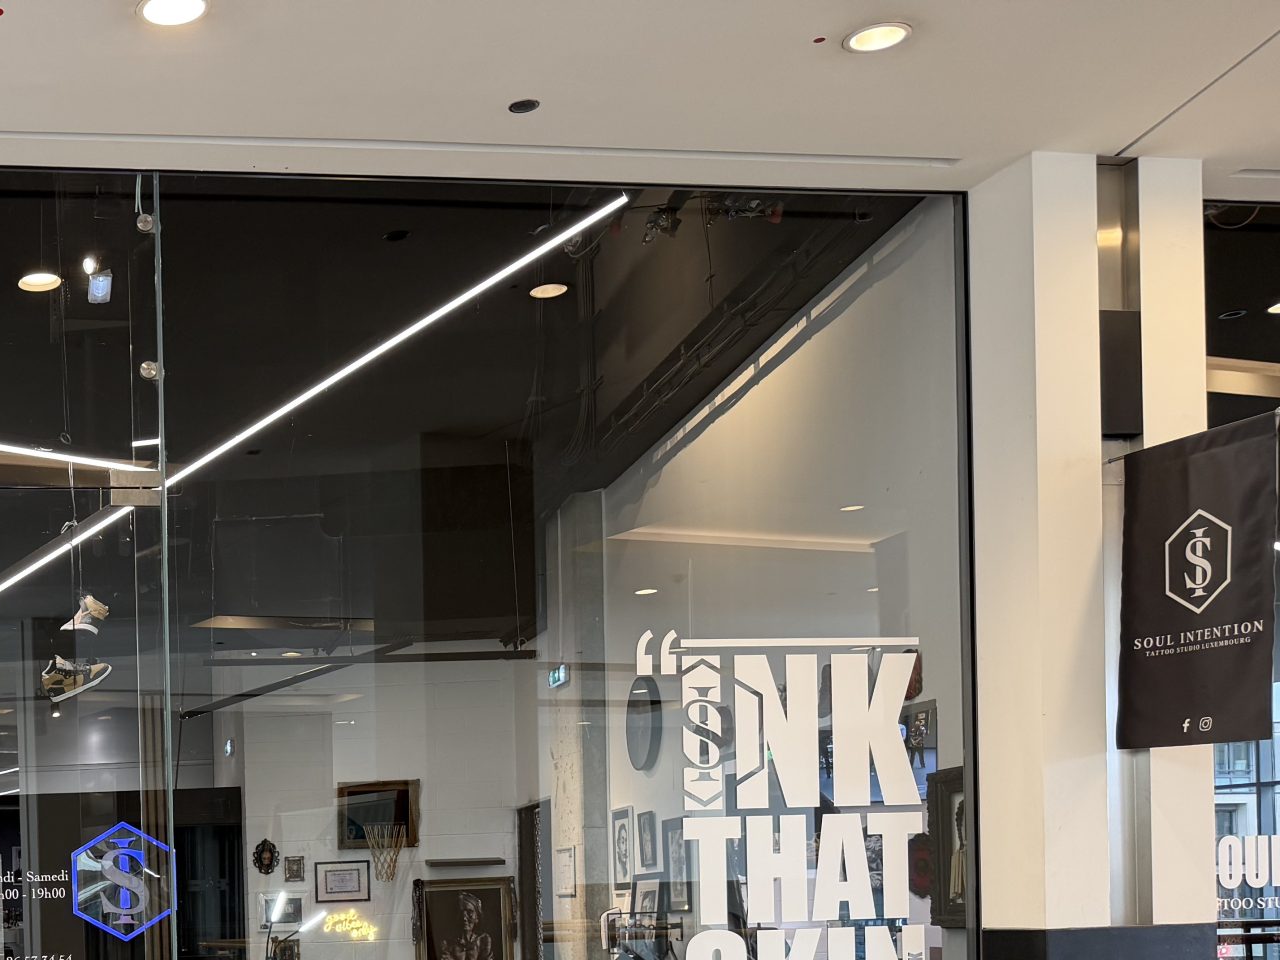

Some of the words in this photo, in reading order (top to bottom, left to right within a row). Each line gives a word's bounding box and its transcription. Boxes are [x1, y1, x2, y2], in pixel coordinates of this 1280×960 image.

[1134, 634, 1174, 650] SOUL
[1180, 620, 1264, 645] INTENTION
[1145, 648, 1174, 657] TATTOO
[1177, 644, 1200, 654] STUDIO
[1202, 637, 1251, 650] LUXEMBOURG
[681, 653, 922, 810] INK
[26, 870, 69, 882] Samedi
[682, 812, 923, 925] THAT
[32, 887, 66, 899] 19h00
